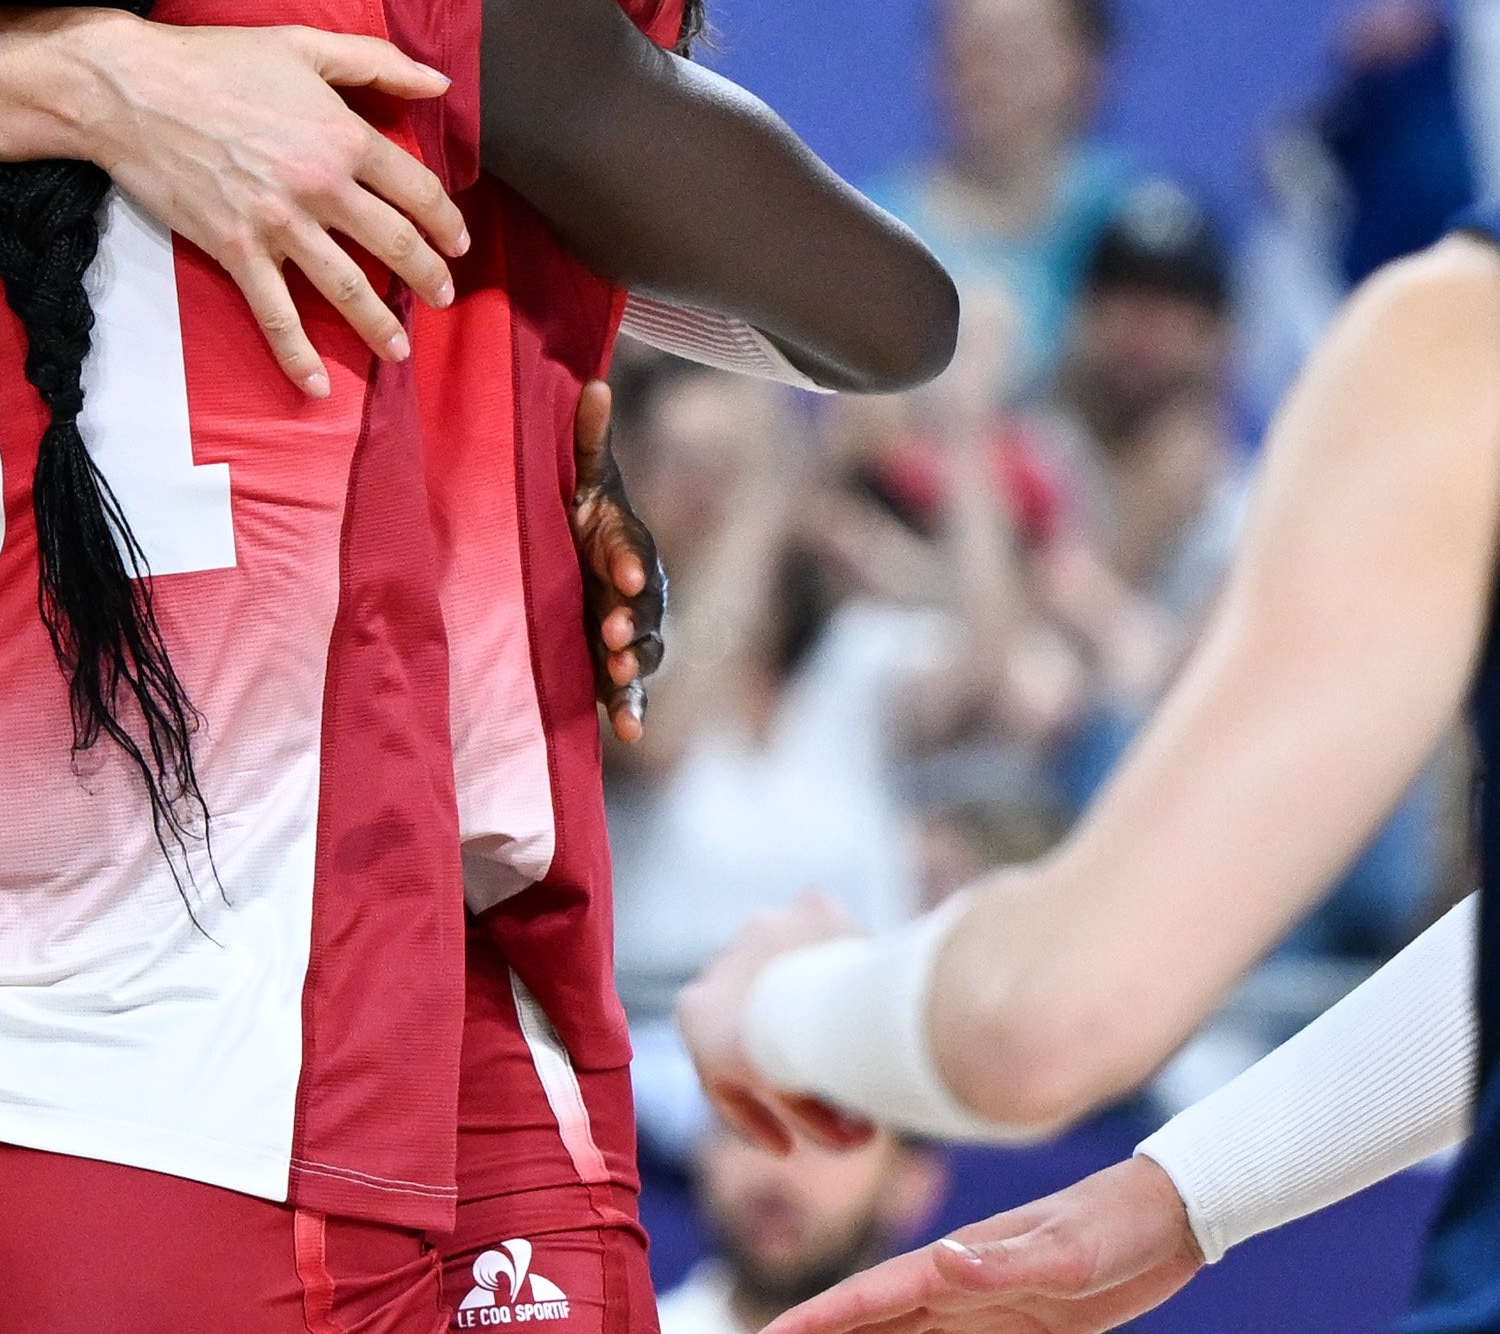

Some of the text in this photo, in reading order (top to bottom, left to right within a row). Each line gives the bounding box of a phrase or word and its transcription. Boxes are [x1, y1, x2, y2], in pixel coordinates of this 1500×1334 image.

[457, 1301, 571, 1328] LE COQ SPORTIF
